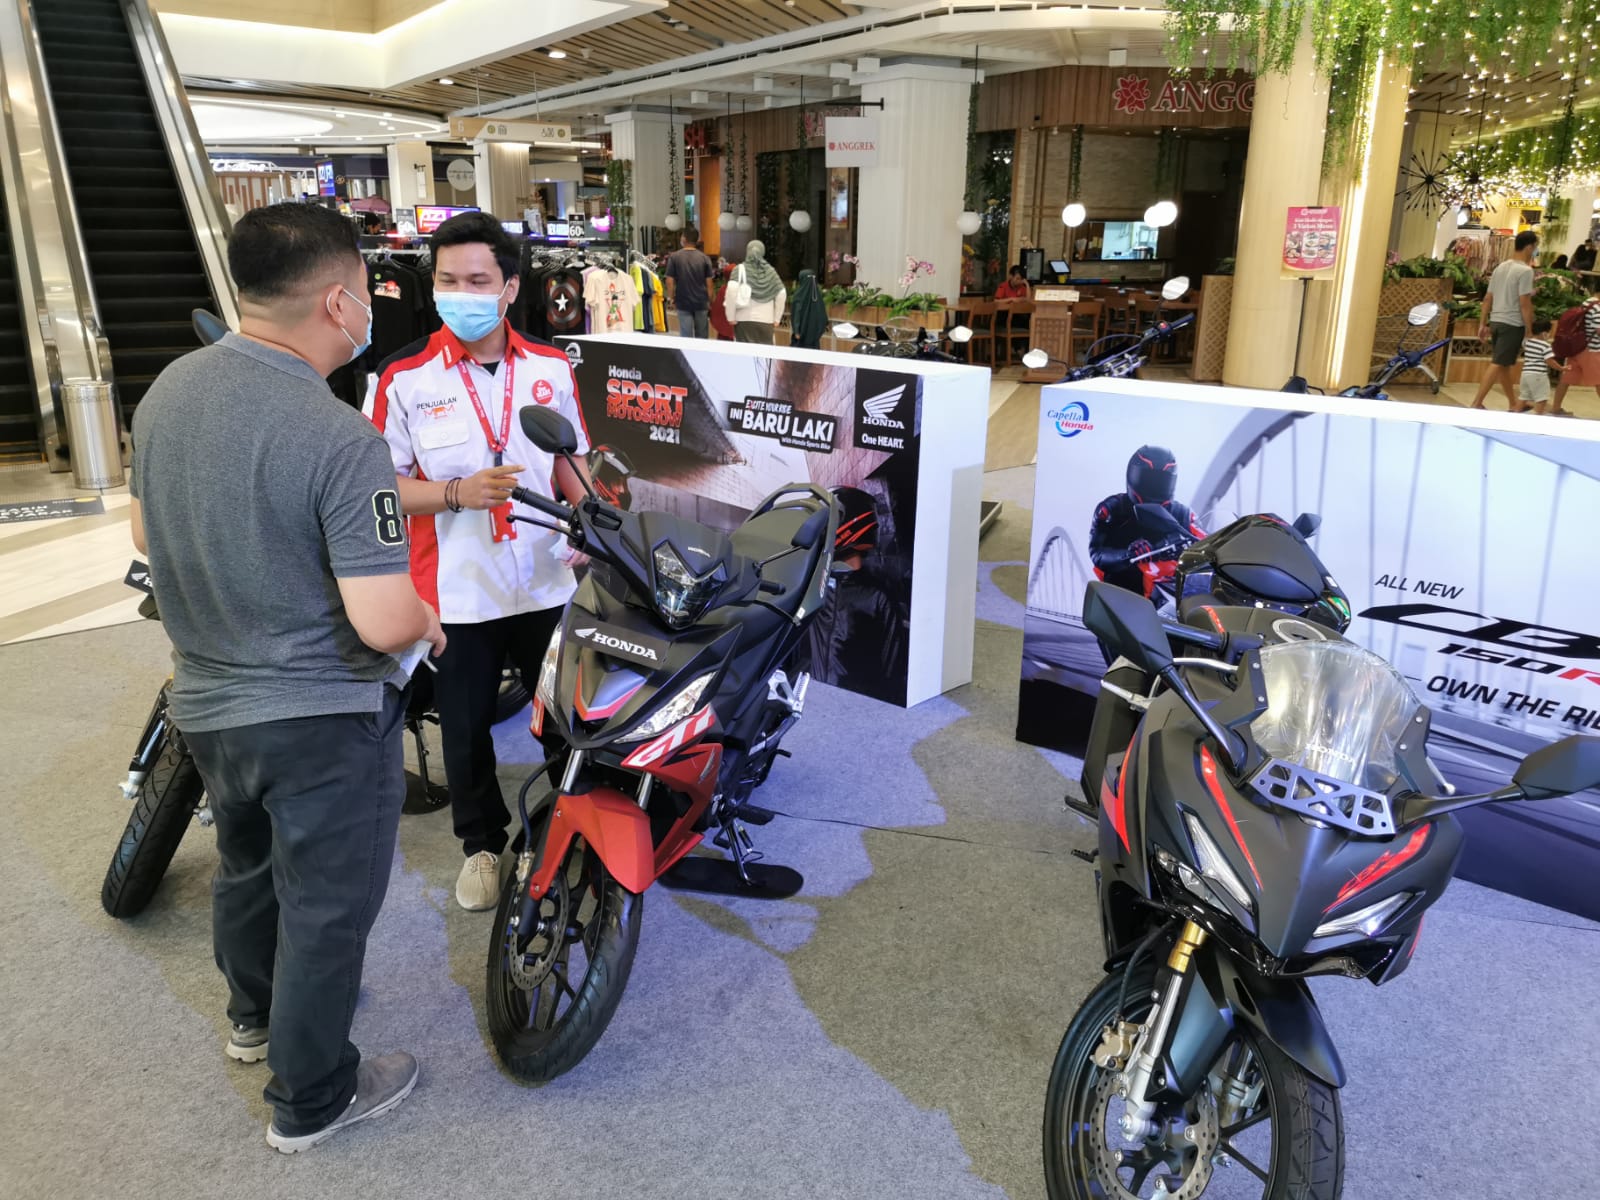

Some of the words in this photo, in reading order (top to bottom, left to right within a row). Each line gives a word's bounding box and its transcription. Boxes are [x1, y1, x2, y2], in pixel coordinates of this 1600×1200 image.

[837, 142, 875, 150] ANGGREK
[608, 365, 642, 379] Honda
[416, 396, 457, 411] PENJUALAN
[607, 378, 688, 412] SPORT
[607, 401, 682, 427] MOTOSHOW
[863, 416, 905, 429] HONDA
[1047, 409, 1082, 421] Capella
[649, 425, 680, 444] 2021
[730, 408, 743, 420] INI
[742, 410, 791, 435] BARU
[791, 416, 835, 442] LAKI
[1061, 420, 1094, 431] Honda
[862, 433, 877, 445] One
[372, 490, 404, 545] 8
[1375, 574, 1407, 591] ALL
[1413, 580, 1464, 599] NEW
[592, 632, 658, 660] HONDA
[1427, 675, 1499, 705] OWN
[1503, 691, 1560, 718] THE
